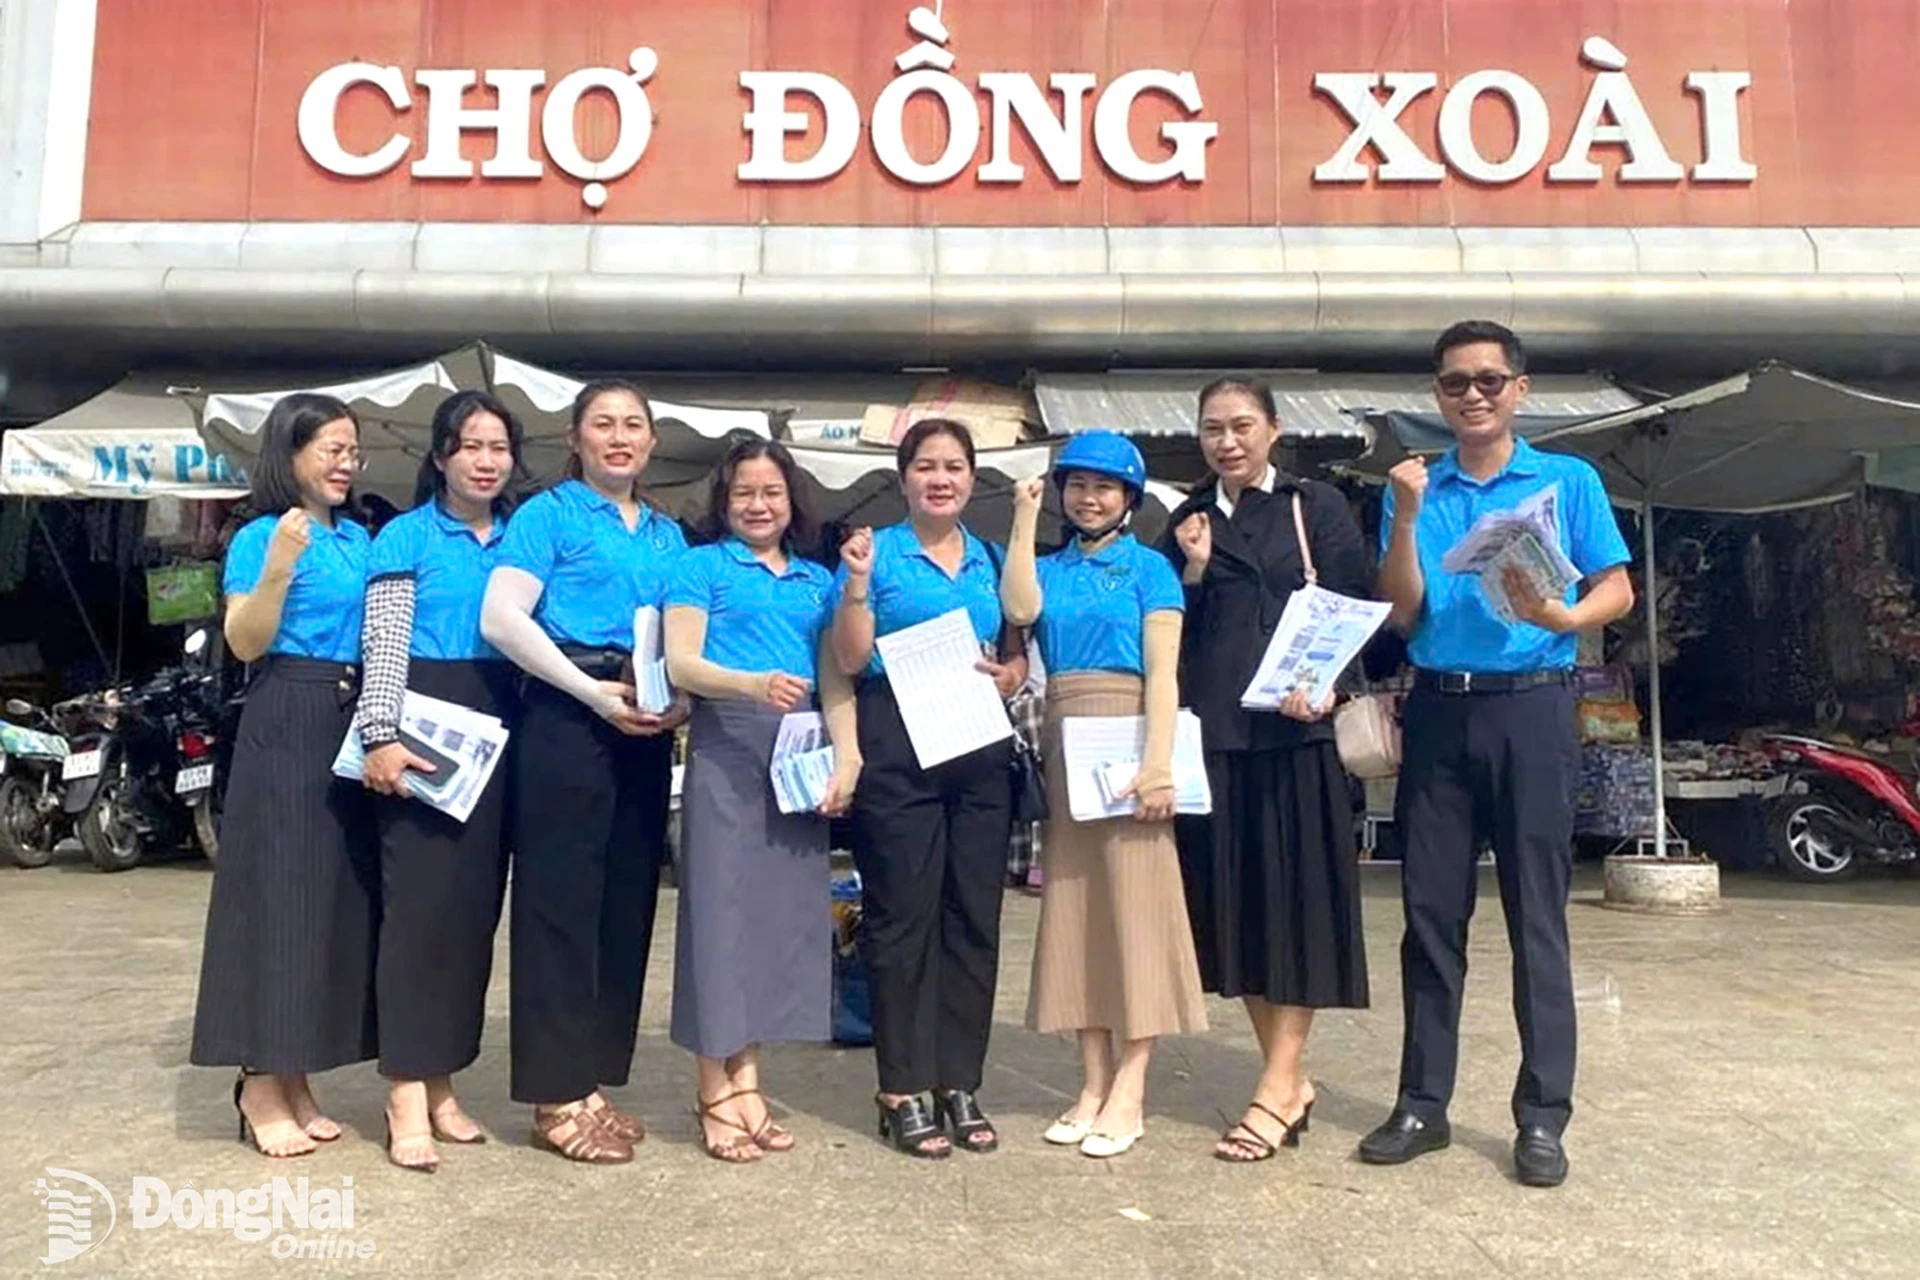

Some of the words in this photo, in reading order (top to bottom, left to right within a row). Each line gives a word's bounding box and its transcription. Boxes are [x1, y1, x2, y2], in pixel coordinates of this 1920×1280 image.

[298, 46, 659, 208] CHỢ
[737, 6, 1219, 184] ĐỒNG
[1313, 36, 1758, 183] XOÀI
[91, 442, 155, 494] Mỹ
